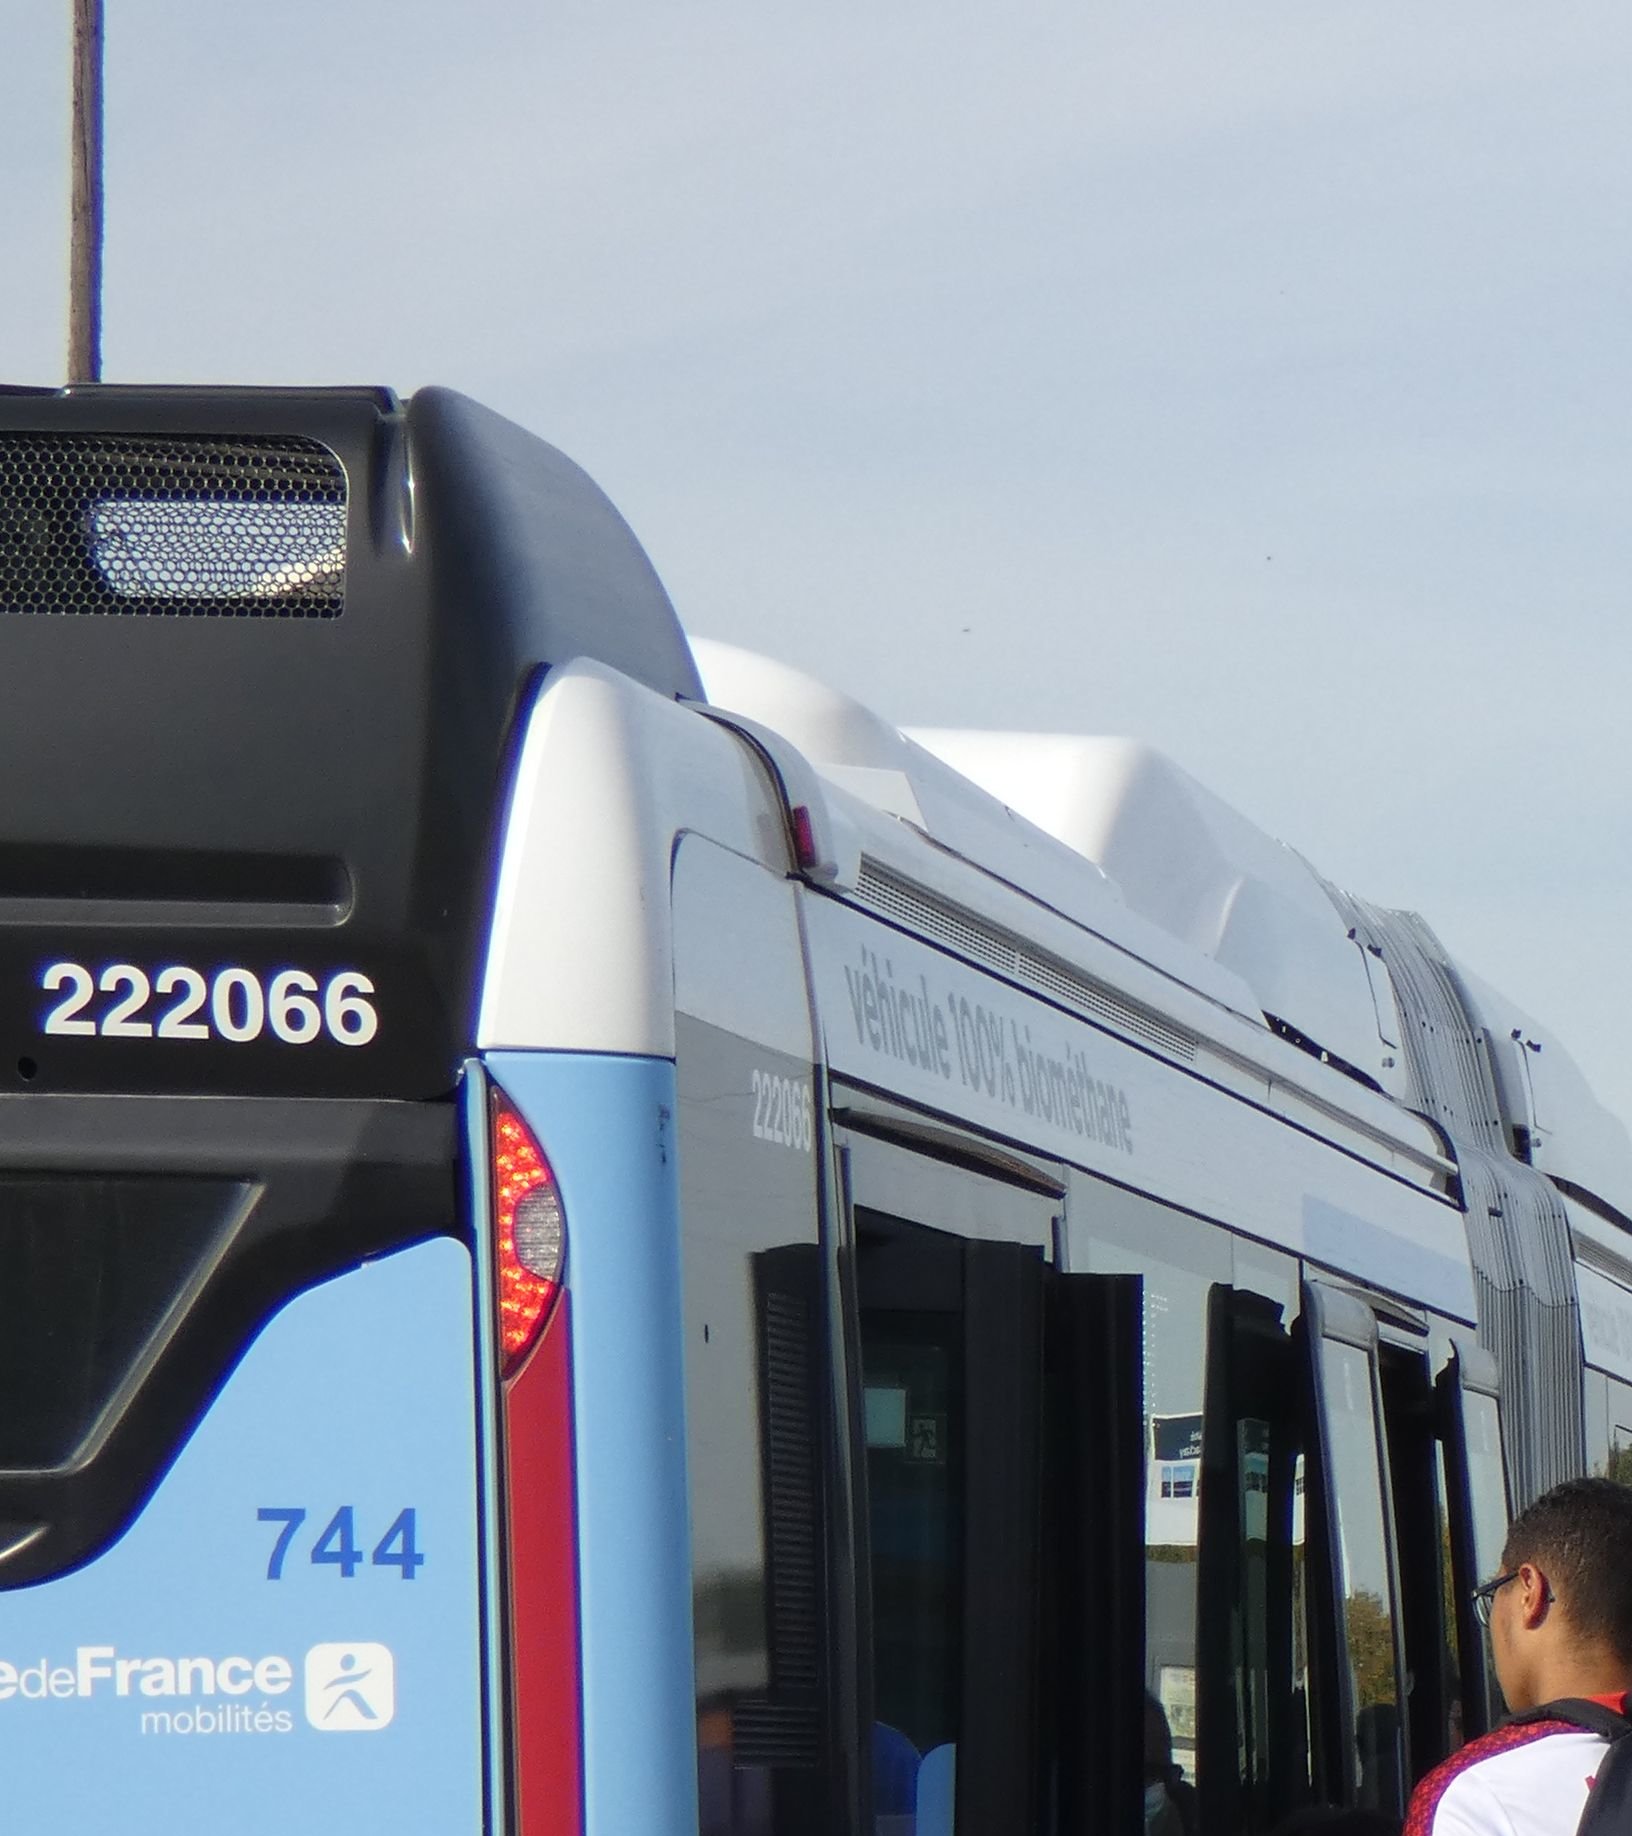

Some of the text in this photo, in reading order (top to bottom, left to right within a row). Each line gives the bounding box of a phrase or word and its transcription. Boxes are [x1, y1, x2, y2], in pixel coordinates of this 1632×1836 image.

[42, 962, 378, 1046] 222066
[844, 943, 1133, 1155] véhicule 100% biométhane
[752, 1069, 811, 1152] 222066
[257, 1506, 424, 1580] 744
[142, 1702, 293, 1734] mobilités
